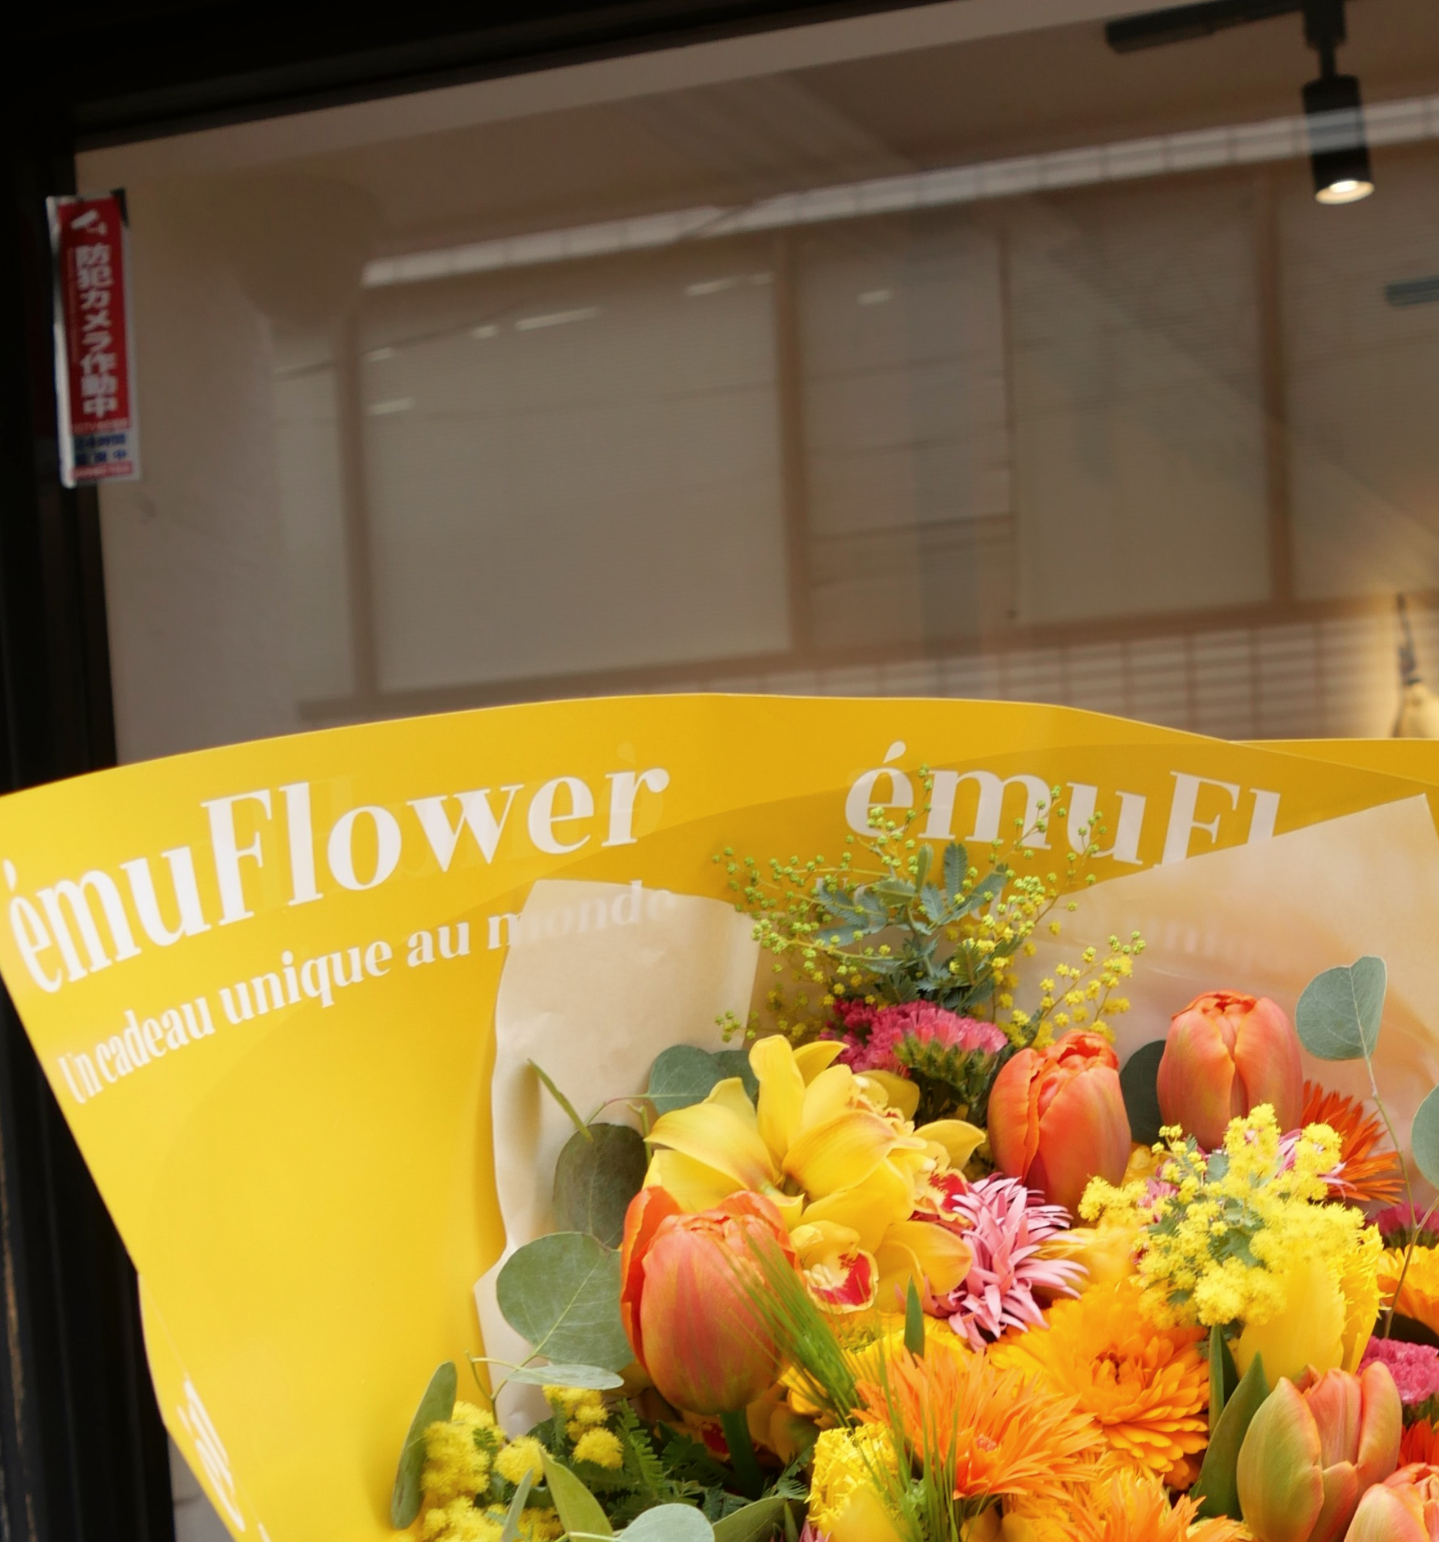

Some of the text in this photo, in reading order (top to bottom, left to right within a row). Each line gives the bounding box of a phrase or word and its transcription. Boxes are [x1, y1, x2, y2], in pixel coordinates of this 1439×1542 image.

[75, 244, 118, 418] 防犯カメラ作動中
[3, 765, 670, 993] émuFlower
[58, 1052, 104, 1104] Un
[95, 997, 216, 1083] cadeau
[219, 940, 393, 1027] unique
[406, 921, 471, 968] au
